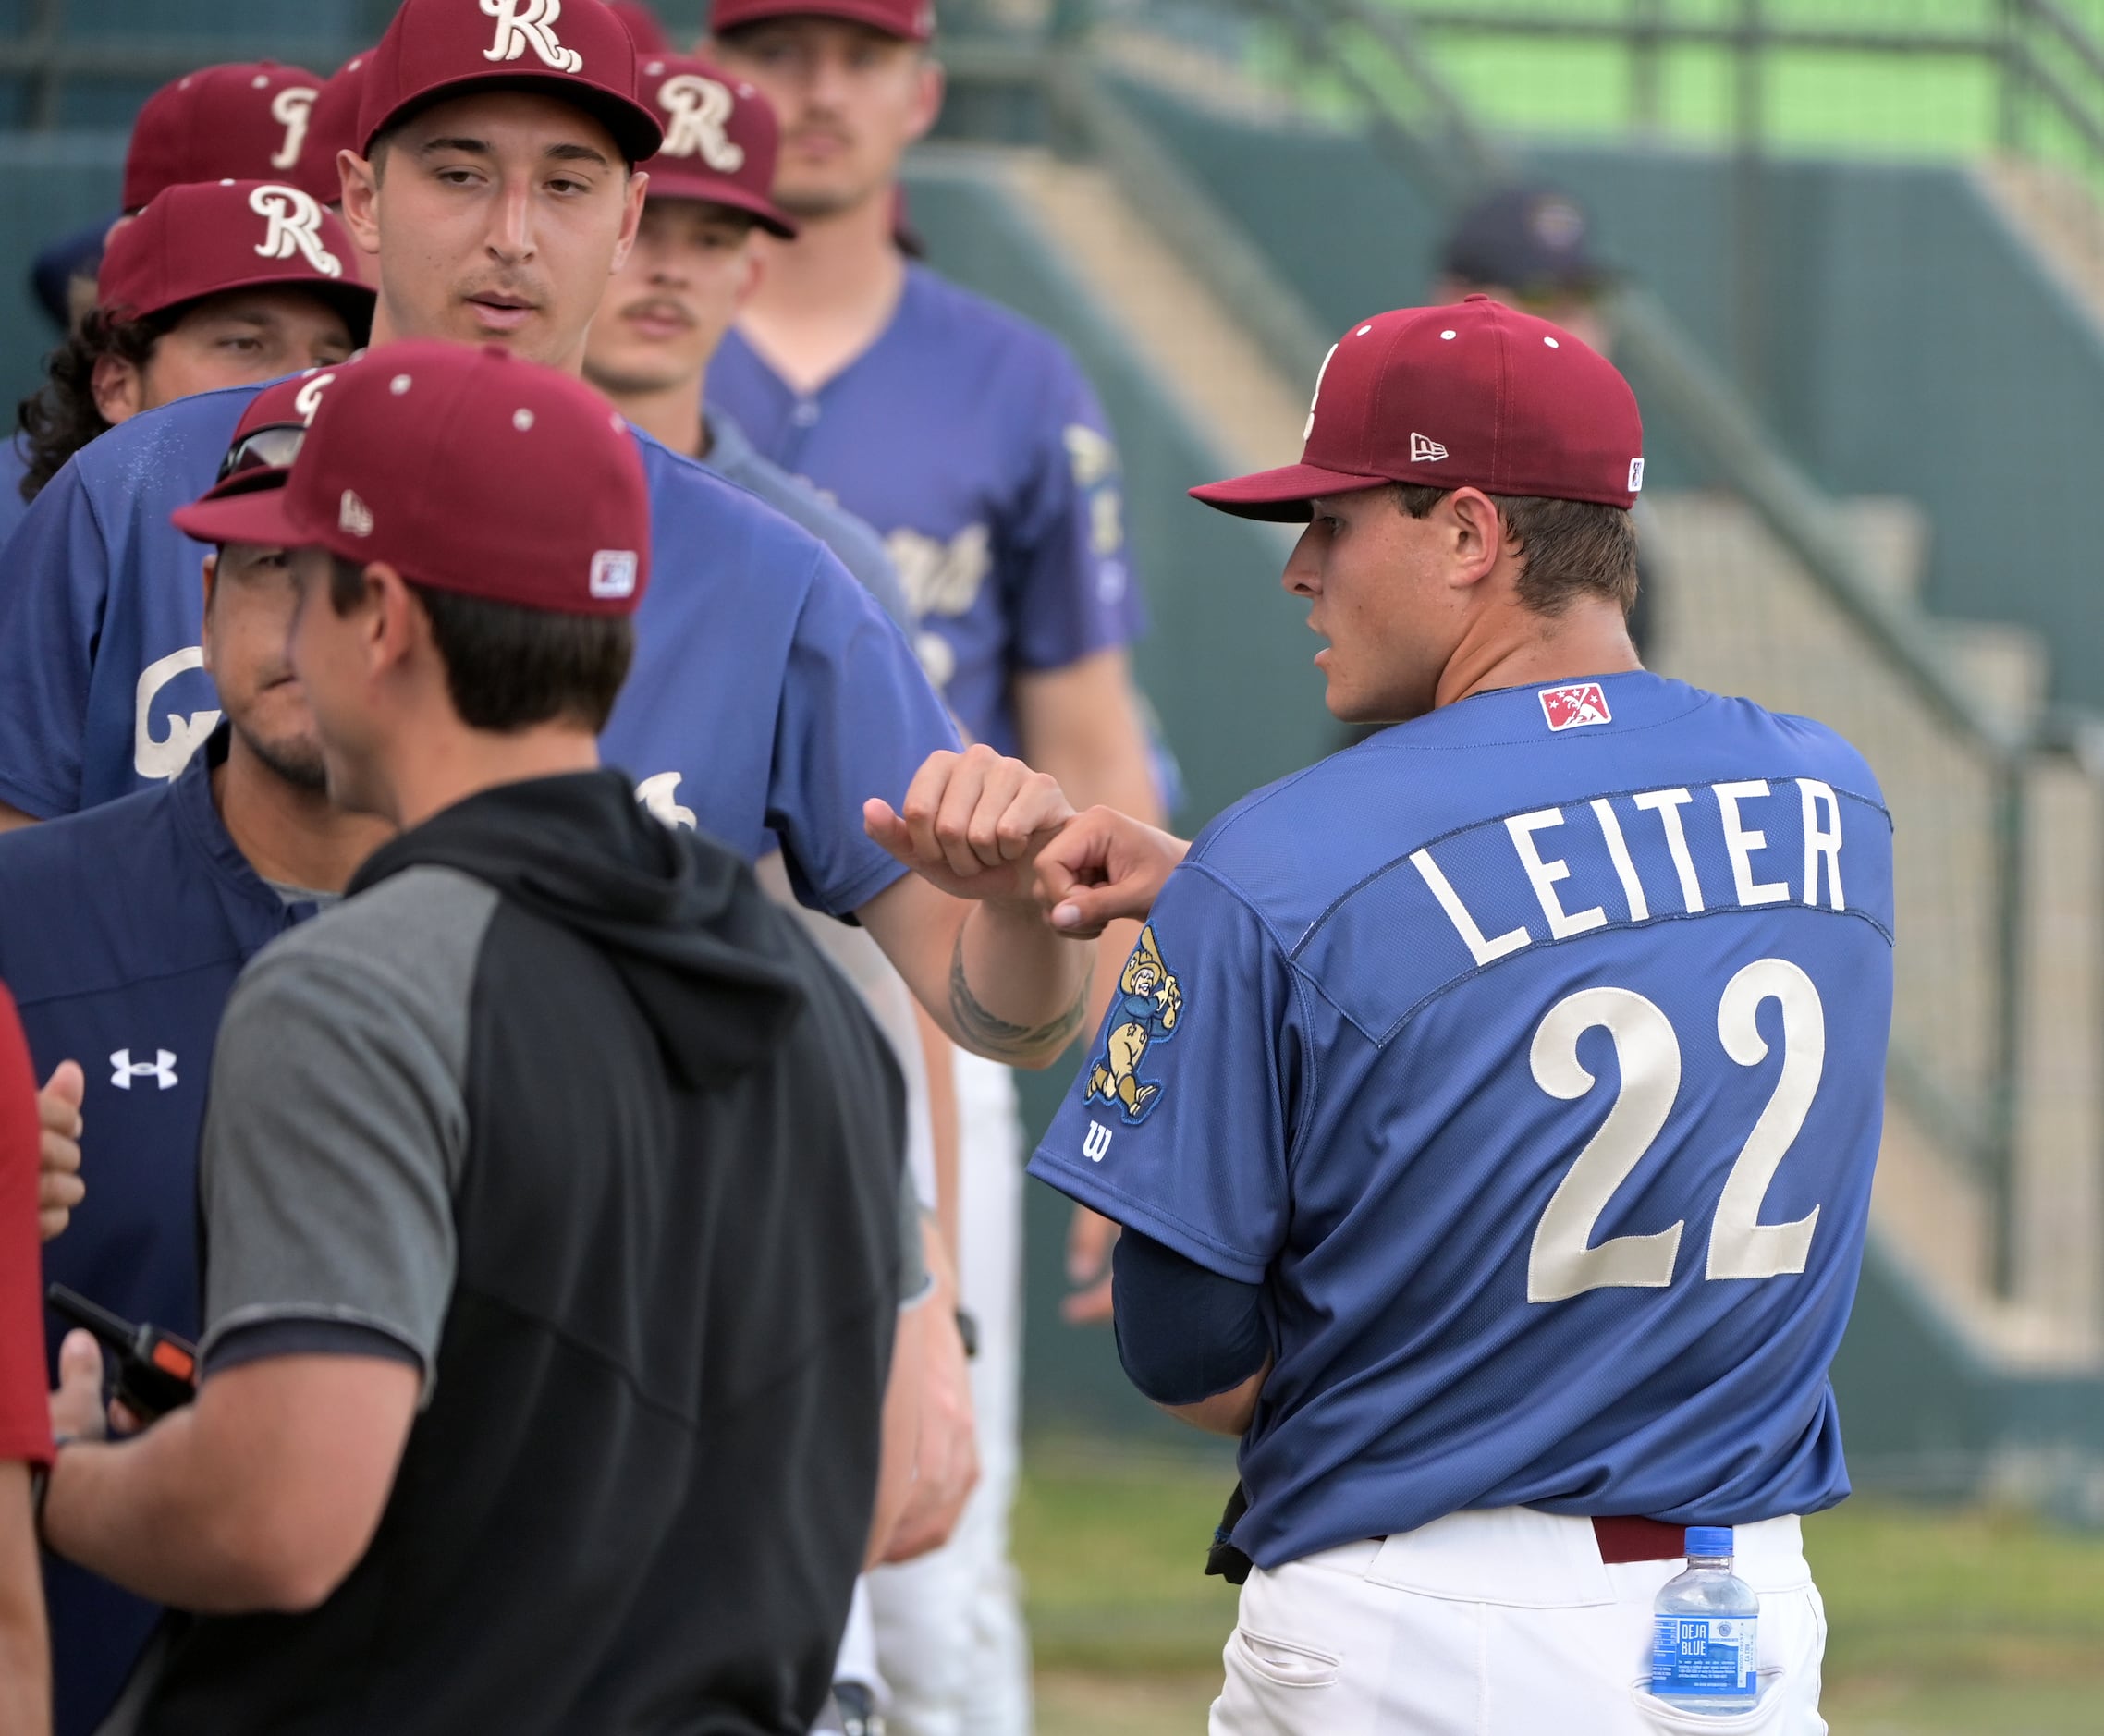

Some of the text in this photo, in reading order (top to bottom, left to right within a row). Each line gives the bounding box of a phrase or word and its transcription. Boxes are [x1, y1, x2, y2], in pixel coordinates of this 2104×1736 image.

[1408, 778, 1845, 967] LEITER
[1527, 958, 1825, 1303] 22
[1682, 1624, 1706, 1639] DEJA
[1682, 1641, 1706, 1656] BLUE
